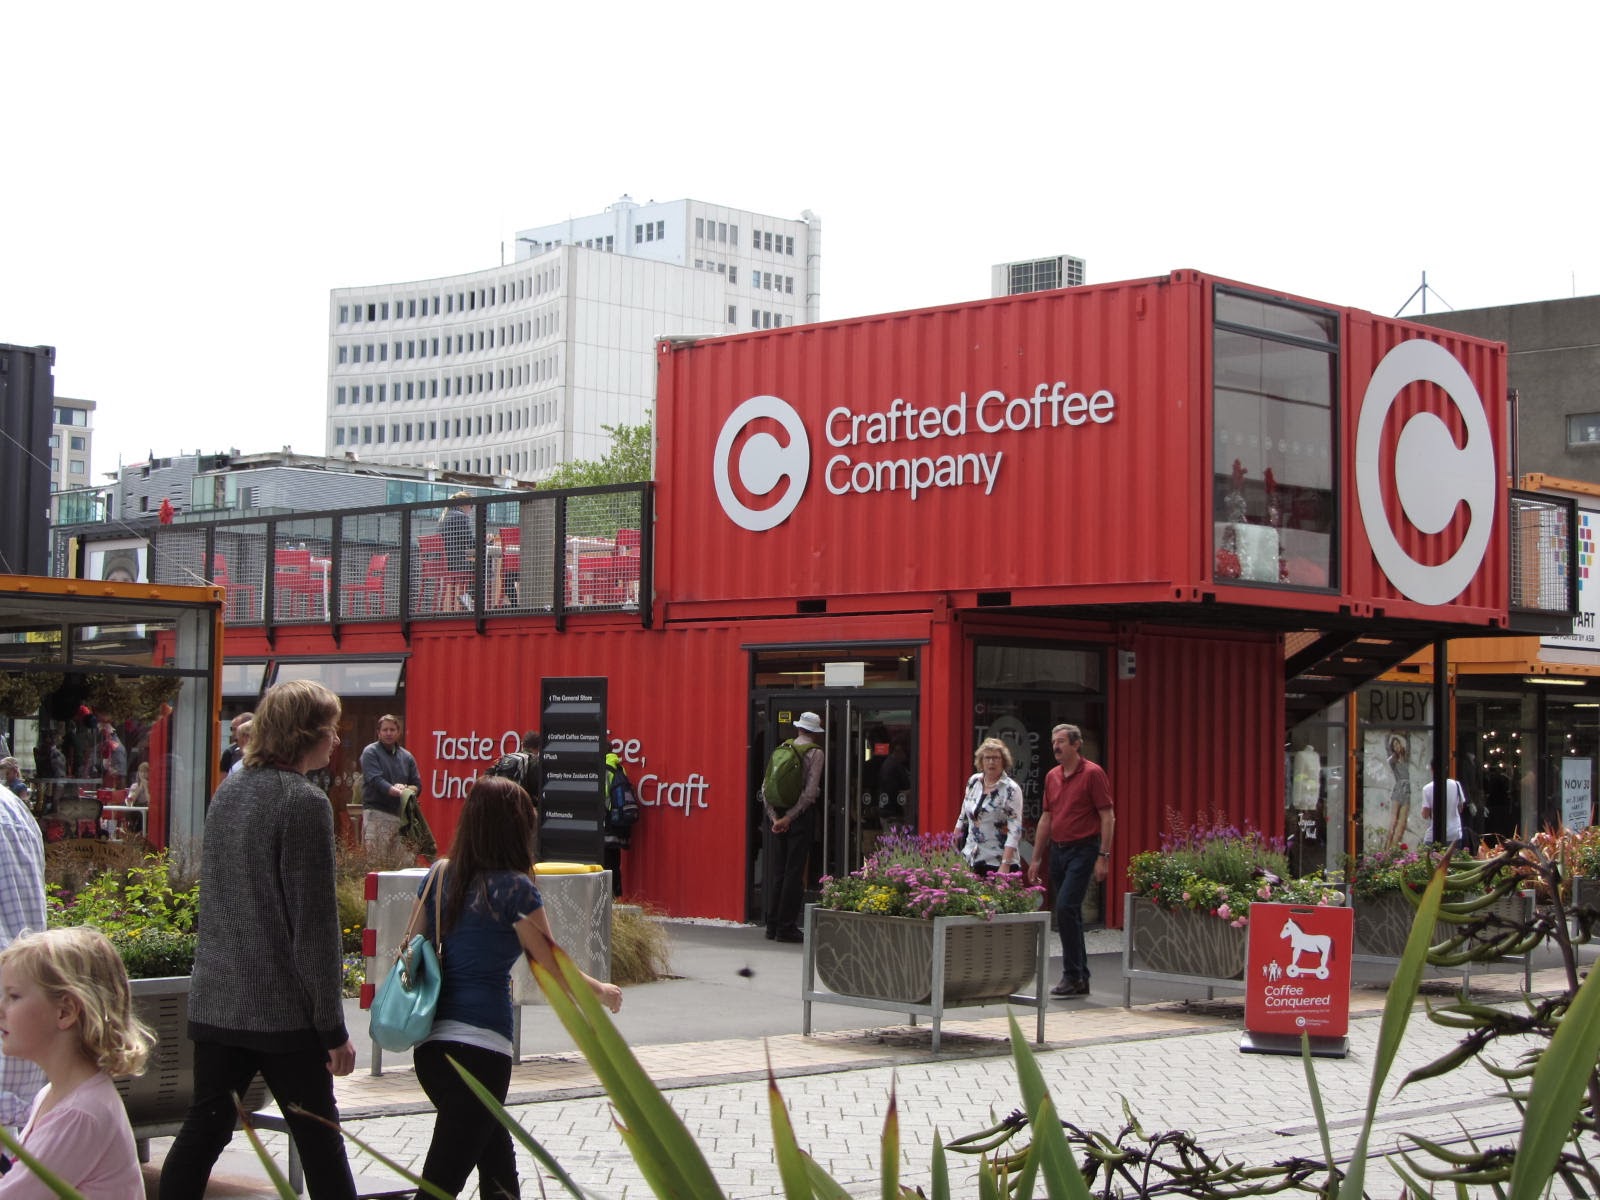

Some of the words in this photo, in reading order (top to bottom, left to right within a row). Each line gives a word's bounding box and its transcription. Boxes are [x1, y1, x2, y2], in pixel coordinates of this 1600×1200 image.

[825, 391, 967, 448] Crafted
[975, 381, 1115, 434] Coffee
[825, 451, 1003, 501] Company
[1572, 611, 1595, 628] TART
[561, 694, 580, 702] General
[1369, 689, 1430, 721] RUBY
[432, 730, 494, 760] Taste
[580, 734, 600, 742] Company
[1564, 779, 1582, 790] NOV
[637, 773, 710, 817] Craft
[1265, 985, 1303, 995] Coffee
[1264, 995, 1330, 1008] Conquered
